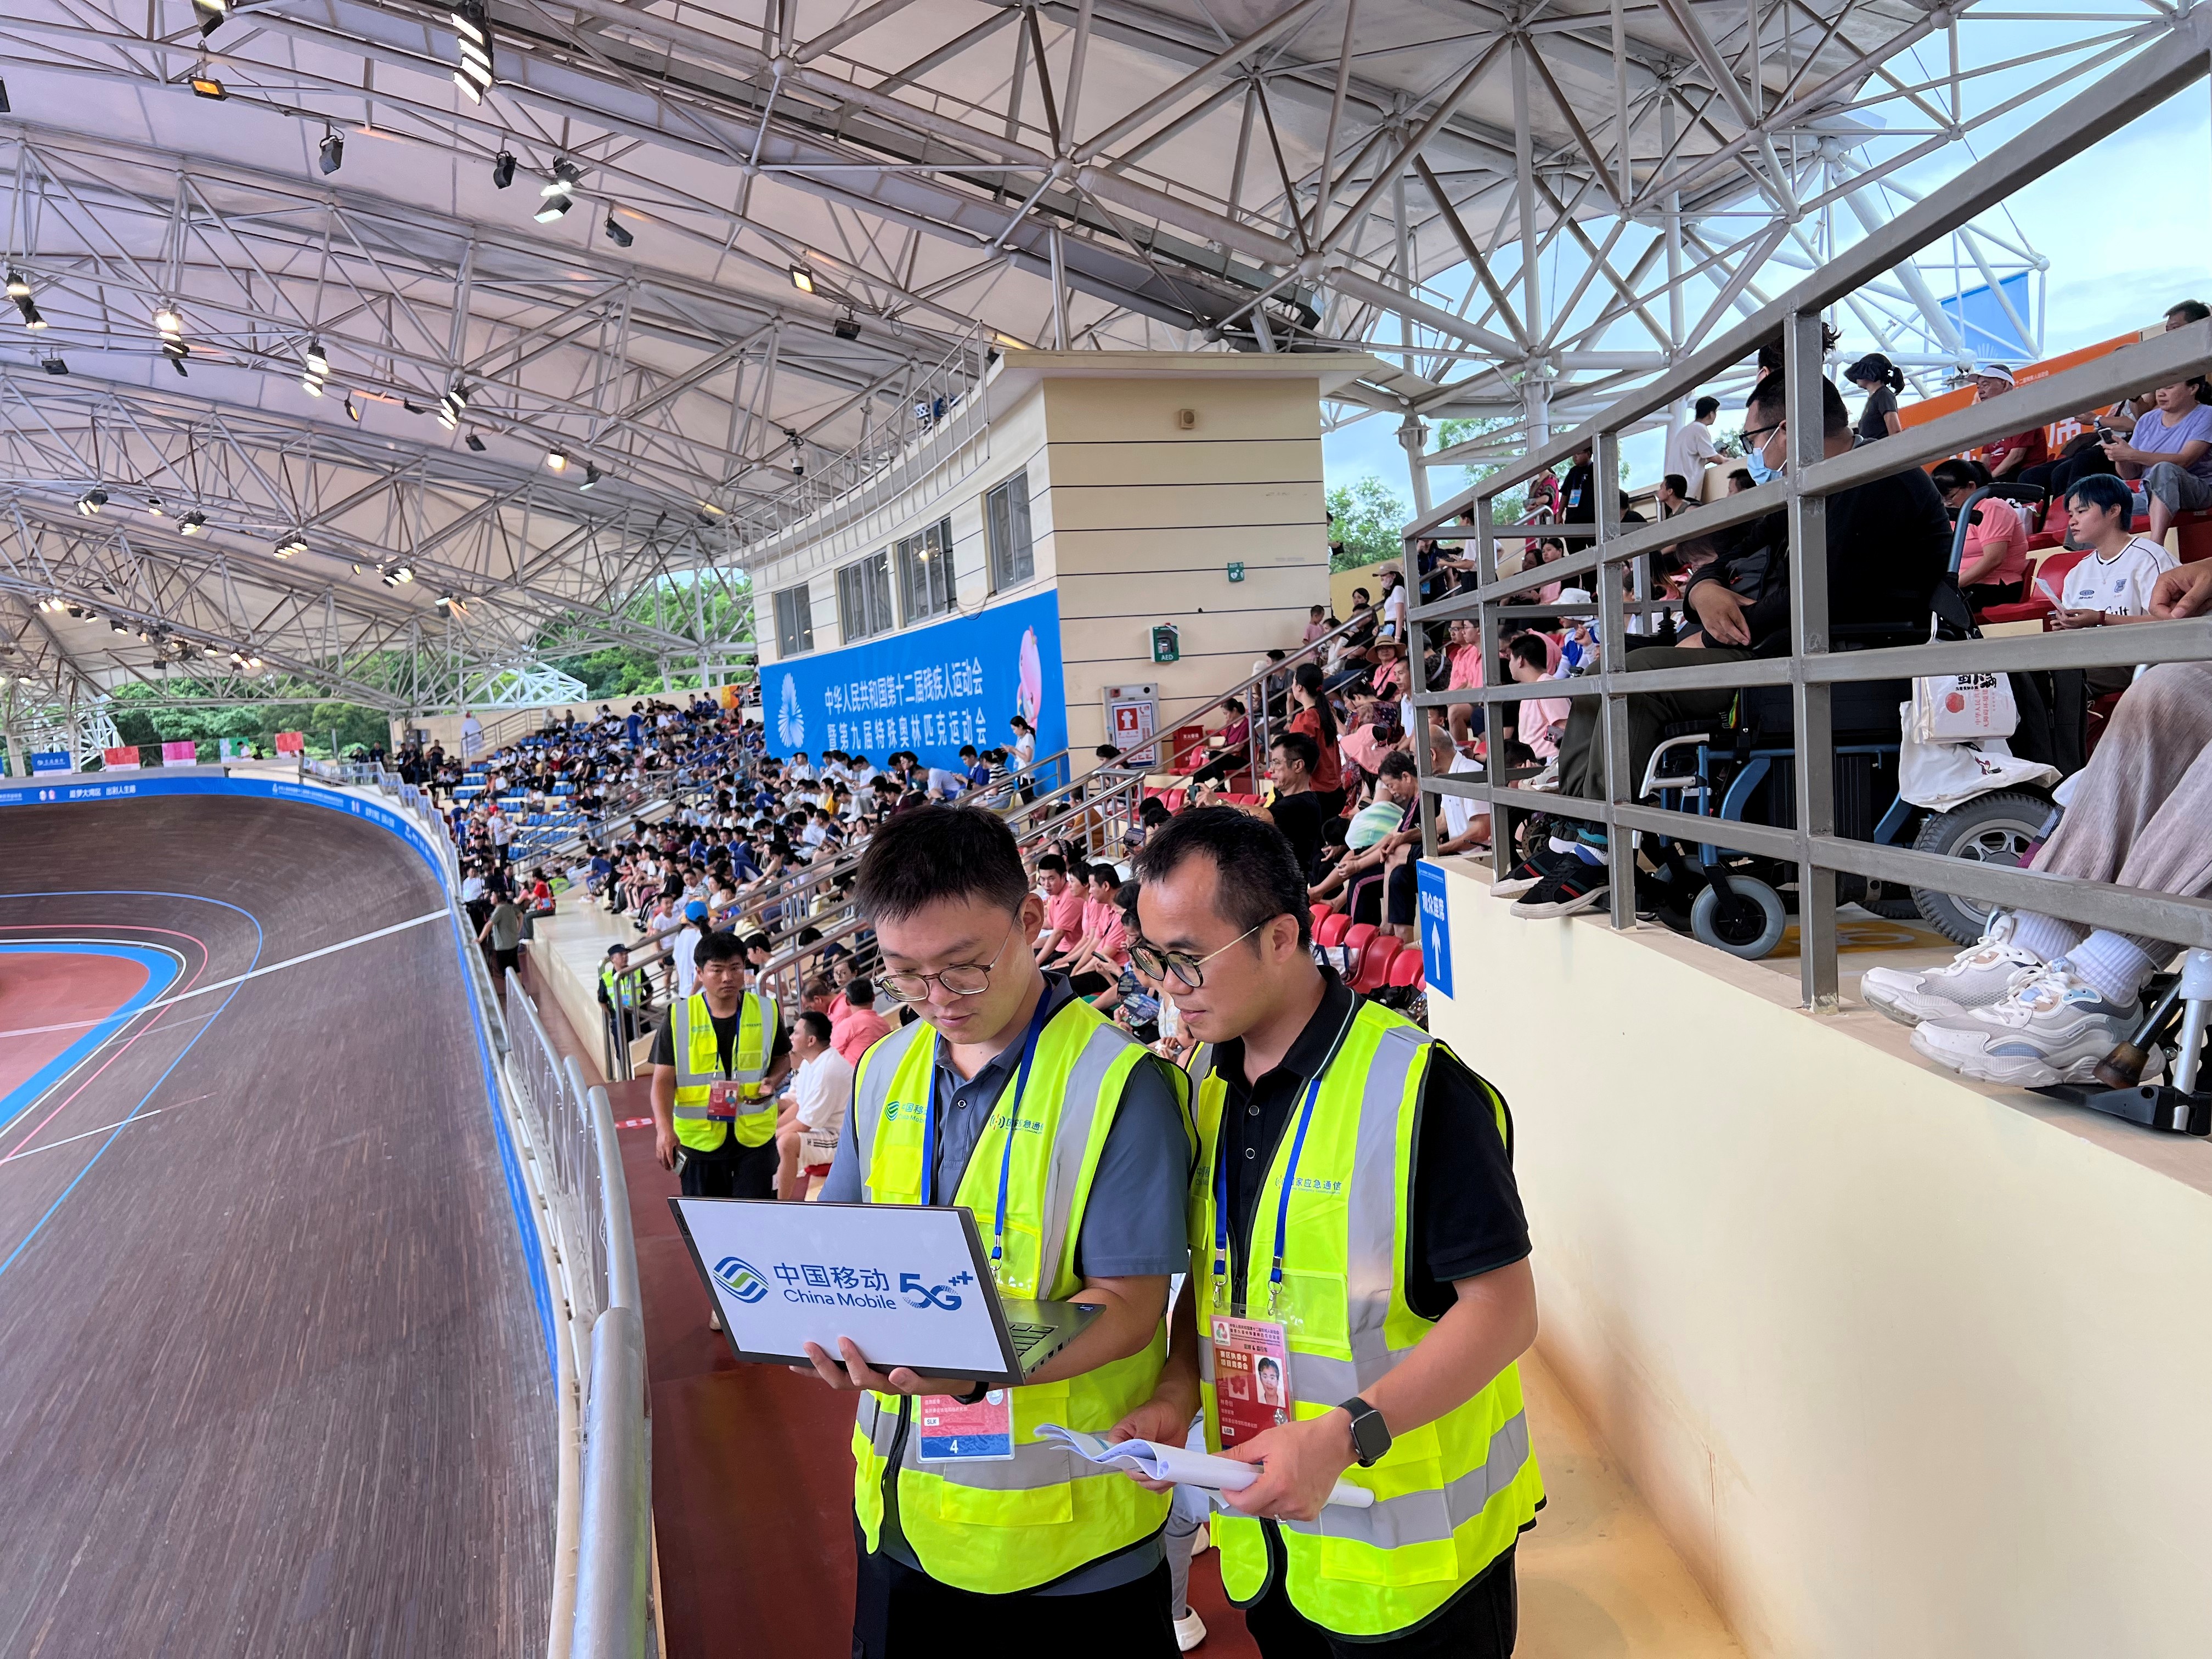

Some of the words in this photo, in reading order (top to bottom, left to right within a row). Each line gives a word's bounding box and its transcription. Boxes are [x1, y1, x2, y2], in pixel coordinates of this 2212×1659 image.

[825, 657, 983, 715] 中华人民共和国第十二届残疾人运动会
[827, 707, 986, 751] 暨第九届特殊奥林匹克运动会
[1421, 890, 1444, 921] 观众座席
[1292, 1177, 1342, 1190] 家应急通信
[773, 1262, 890, 1291] 中国移动
[783, 1289, 835, 1305] China
[837, 1292, 897, 1310] Mobile
[950, 1439, 959, 1454] 4
